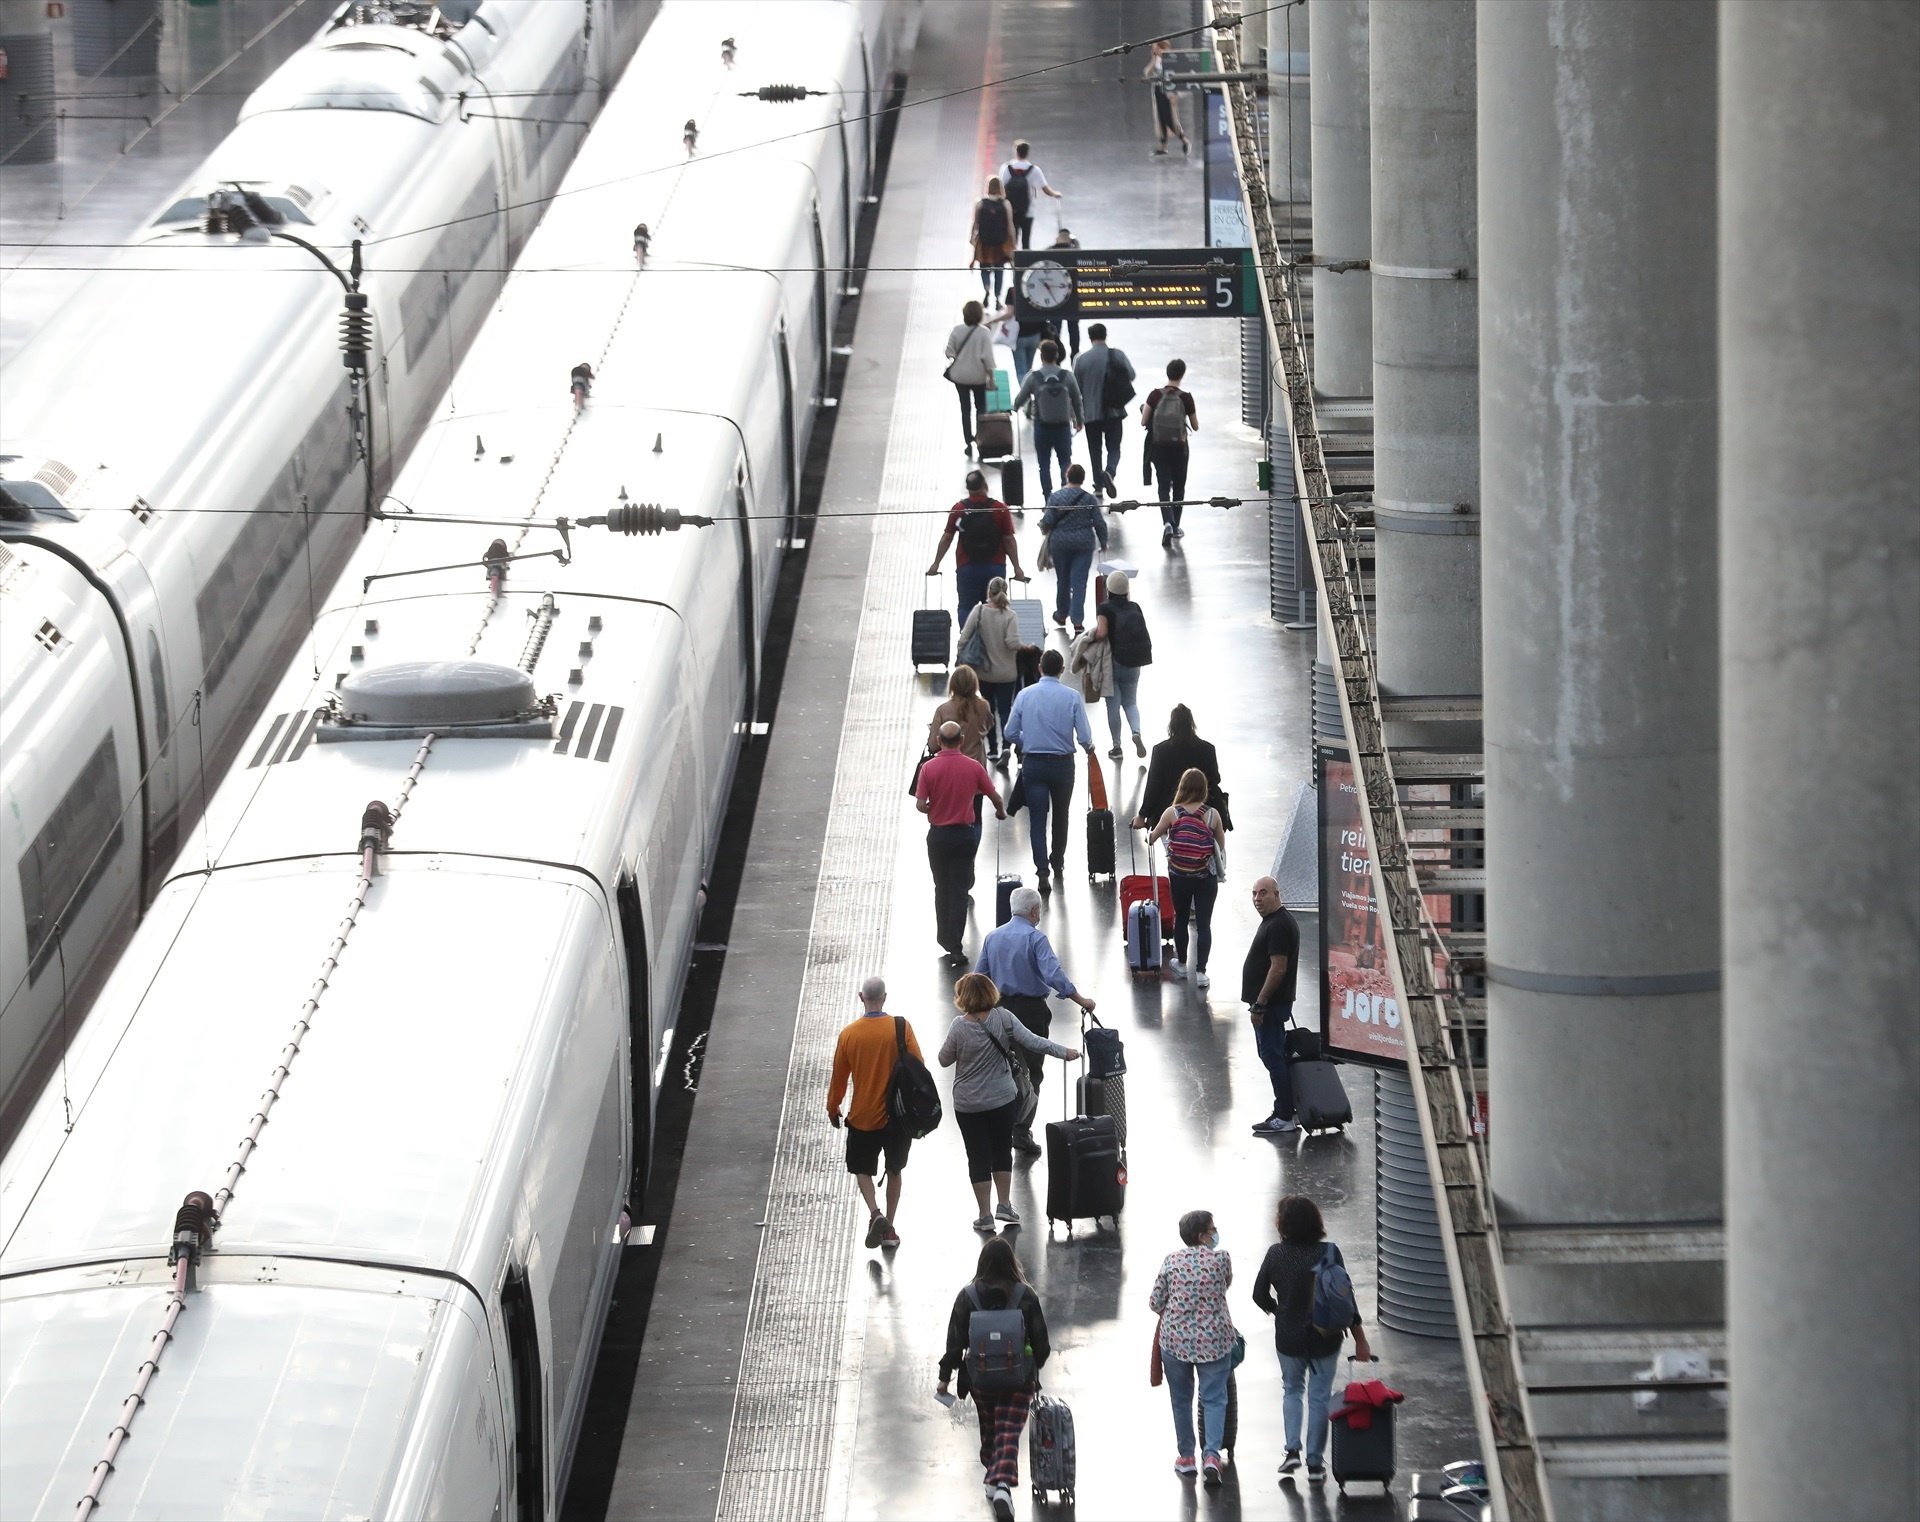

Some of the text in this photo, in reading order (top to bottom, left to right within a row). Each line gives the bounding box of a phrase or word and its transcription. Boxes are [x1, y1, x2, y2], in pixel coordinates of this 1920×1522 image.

[1216, 277, 1233, 308] 5
[1341, 890, 1367, 902] Viajamos
[1341, 900, 1358, 910] Vuela
